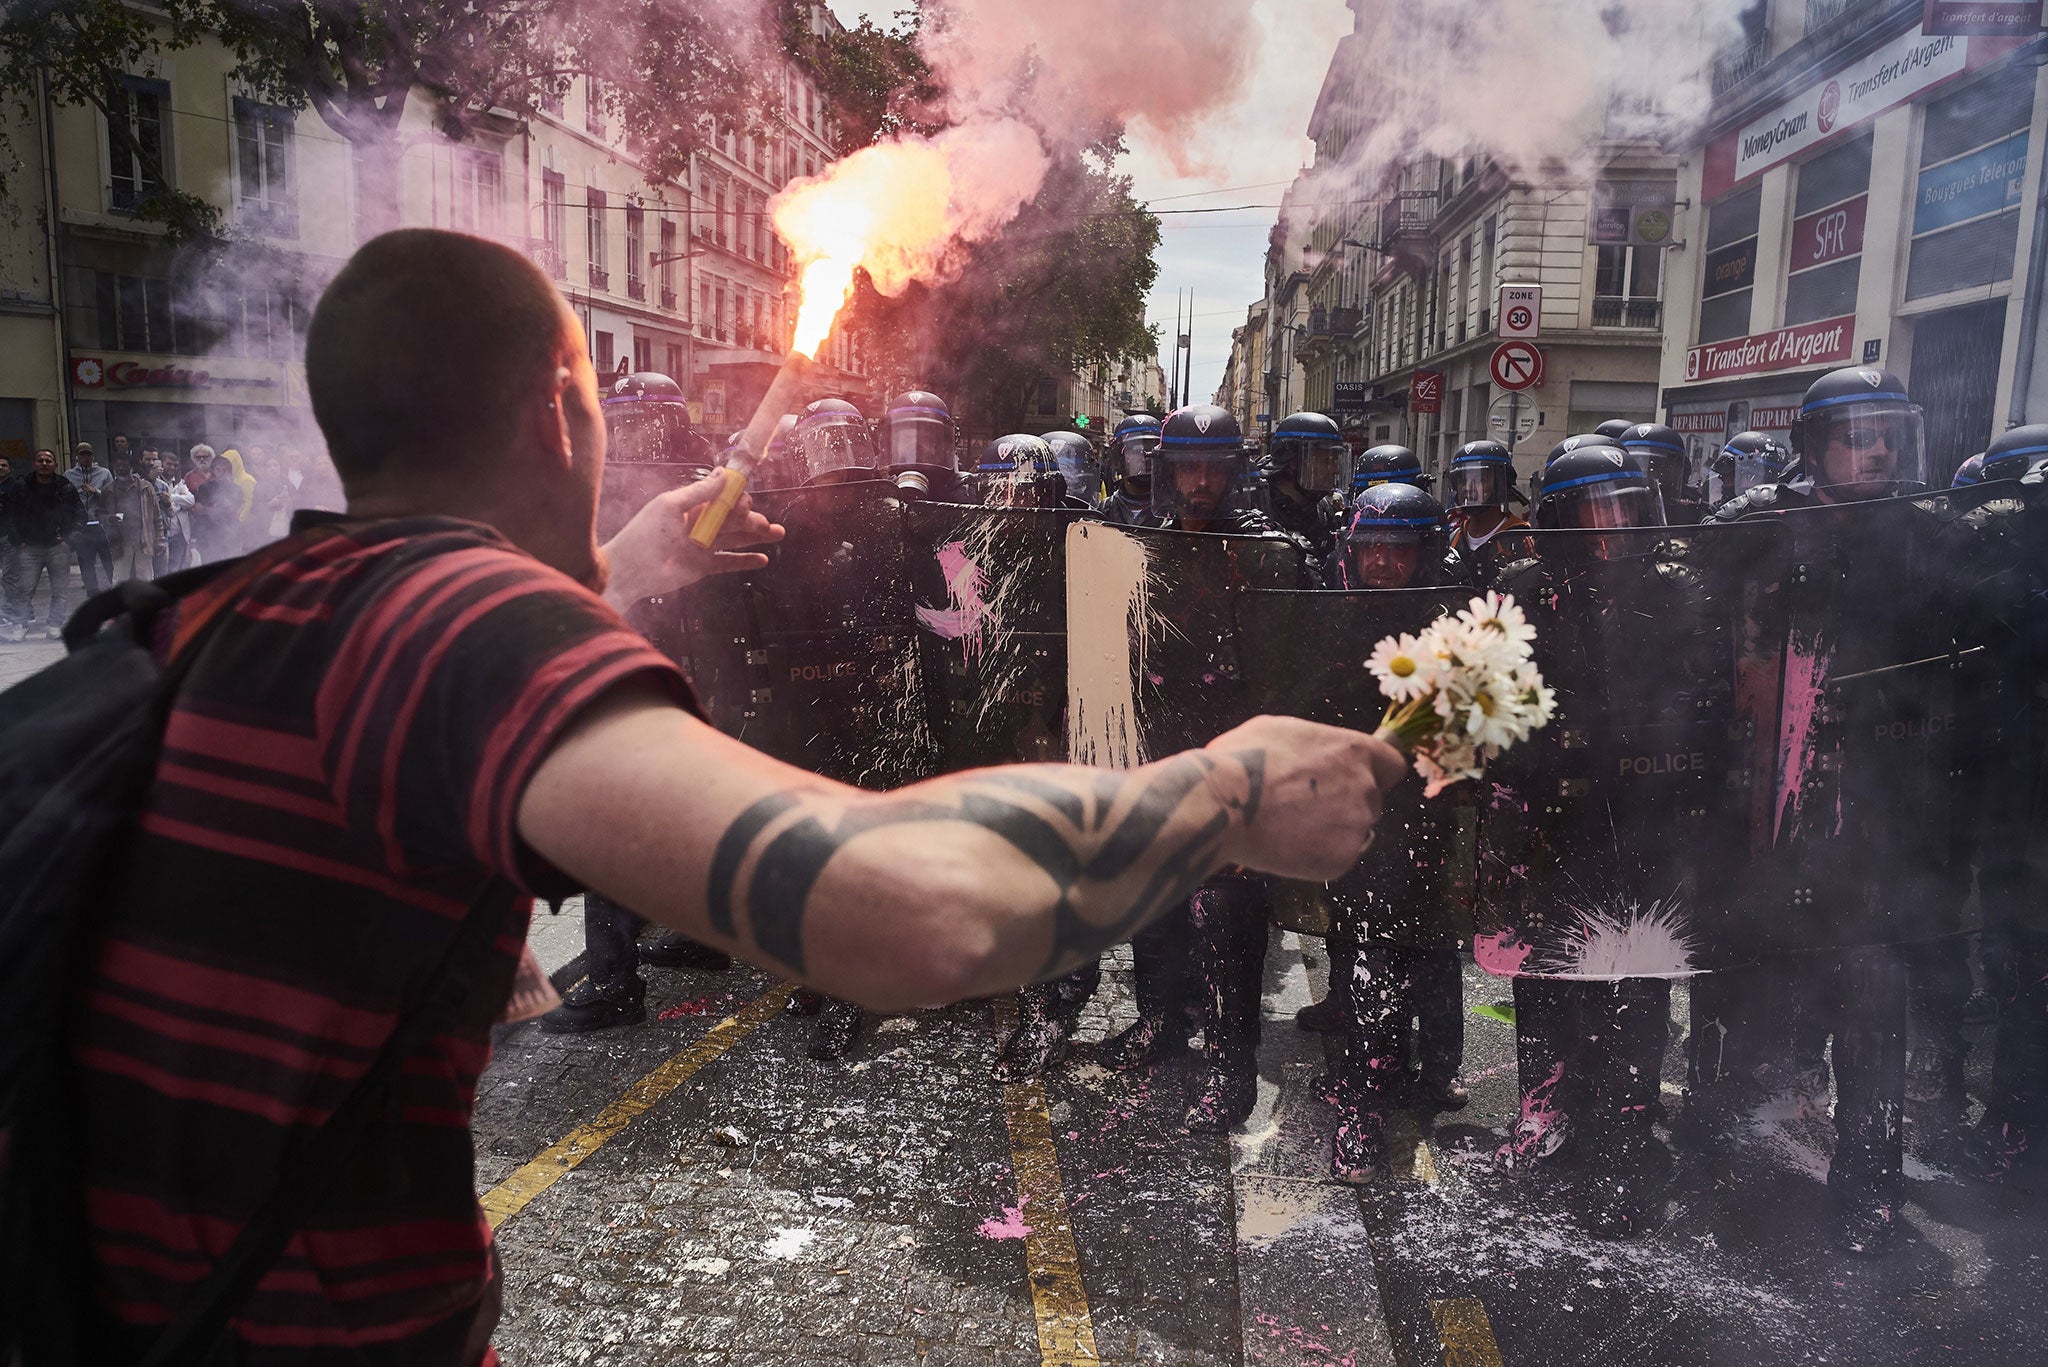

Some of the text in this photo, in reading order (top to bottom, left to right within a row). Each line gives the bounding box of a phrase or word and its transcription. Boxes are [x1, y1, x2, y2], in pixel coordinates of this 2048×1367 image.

[1941, 11, 1985, 24] Transfert
[1848, 60, 1900, 104] Transfert
[1742, 111, 1808, 161] MoneyGram
[1924, 175, 1976, 205] Bouygues
[1813, 210, 1847, 260] SFR
[1716, 256, 1748, 281] orange
[1509, 291, 1533, 300] ZONE
[1511, 312, 1528, 324] 30
[1705, 325, 1843, 372] Transfert d'Argent
[106, 361, 210, 386] Casino
[1336, 383, 1363, 391] OASIS
[1672, 412, 1725, 430] REPARATION
[1752, 408, 1803, 428] REPARAT
[790, 661, 857, 682] POLICE
[1873, 713, 1956, 742] POLICE
[1619, 752, 1705, 777] POLICE
